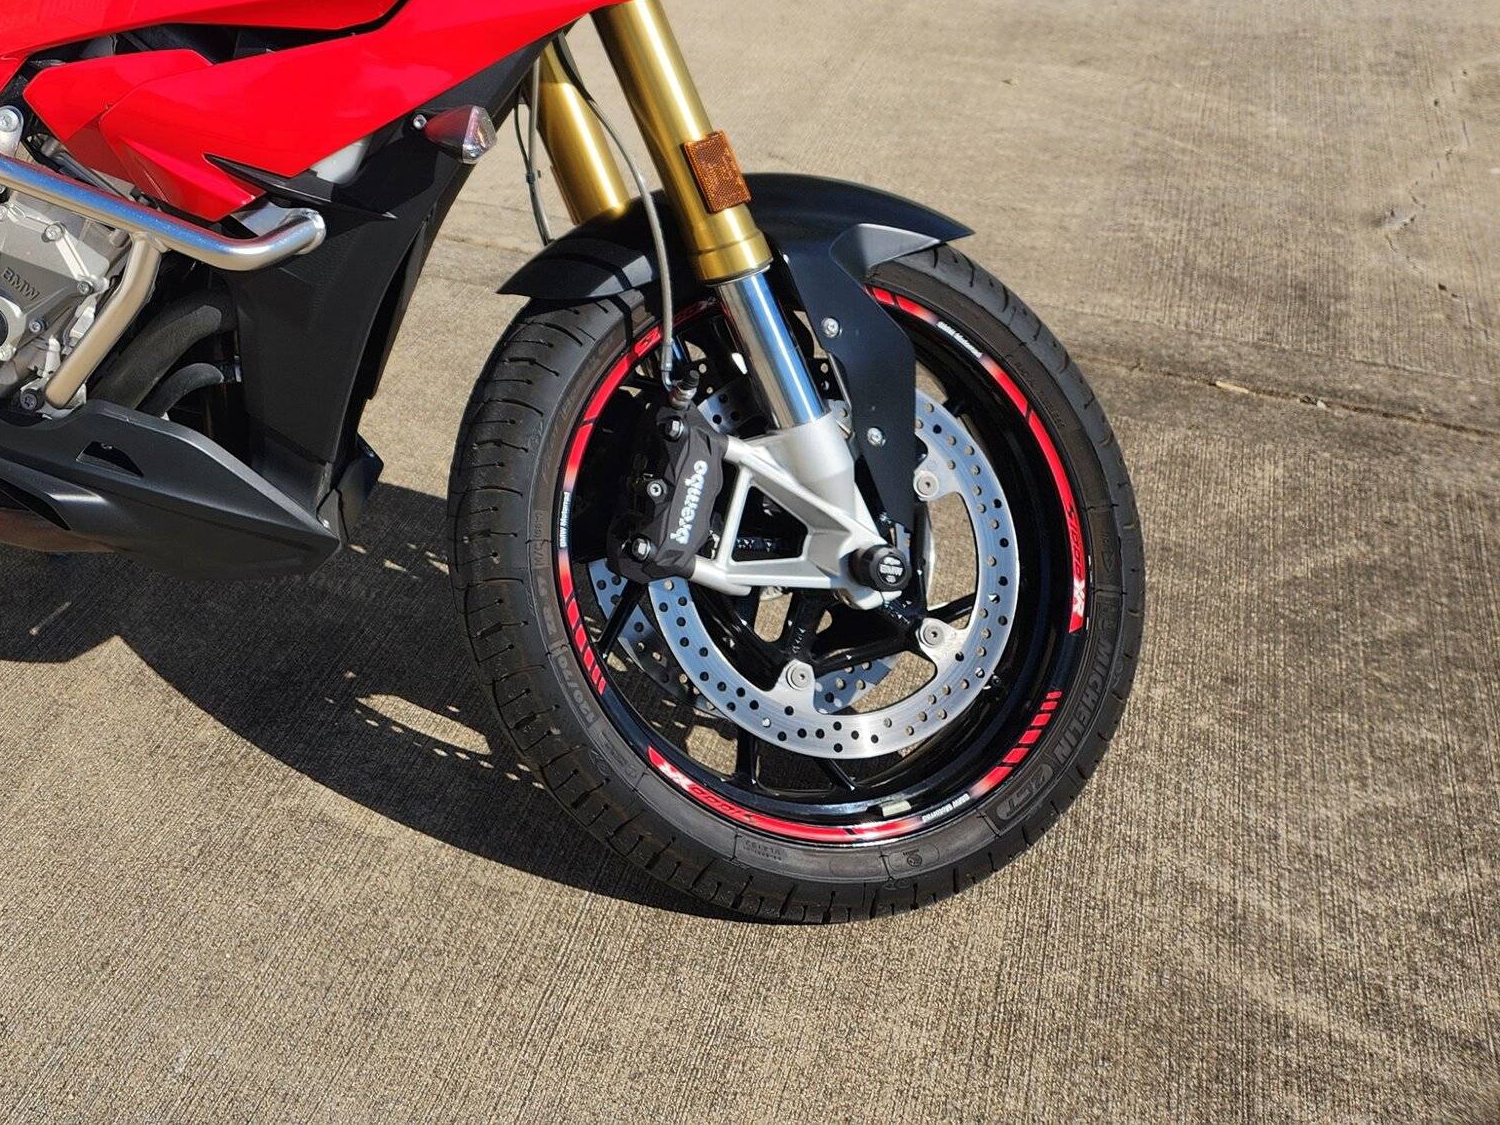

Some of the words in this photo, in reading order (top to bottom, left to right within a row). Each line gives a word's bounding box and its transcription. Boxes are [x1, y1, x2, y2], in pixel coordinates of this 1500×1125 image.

[3, 267, 41, 301] BMW
[670, 460, 708, 545] brembo
[1054, 638, 1114, 764] MICHELIN
